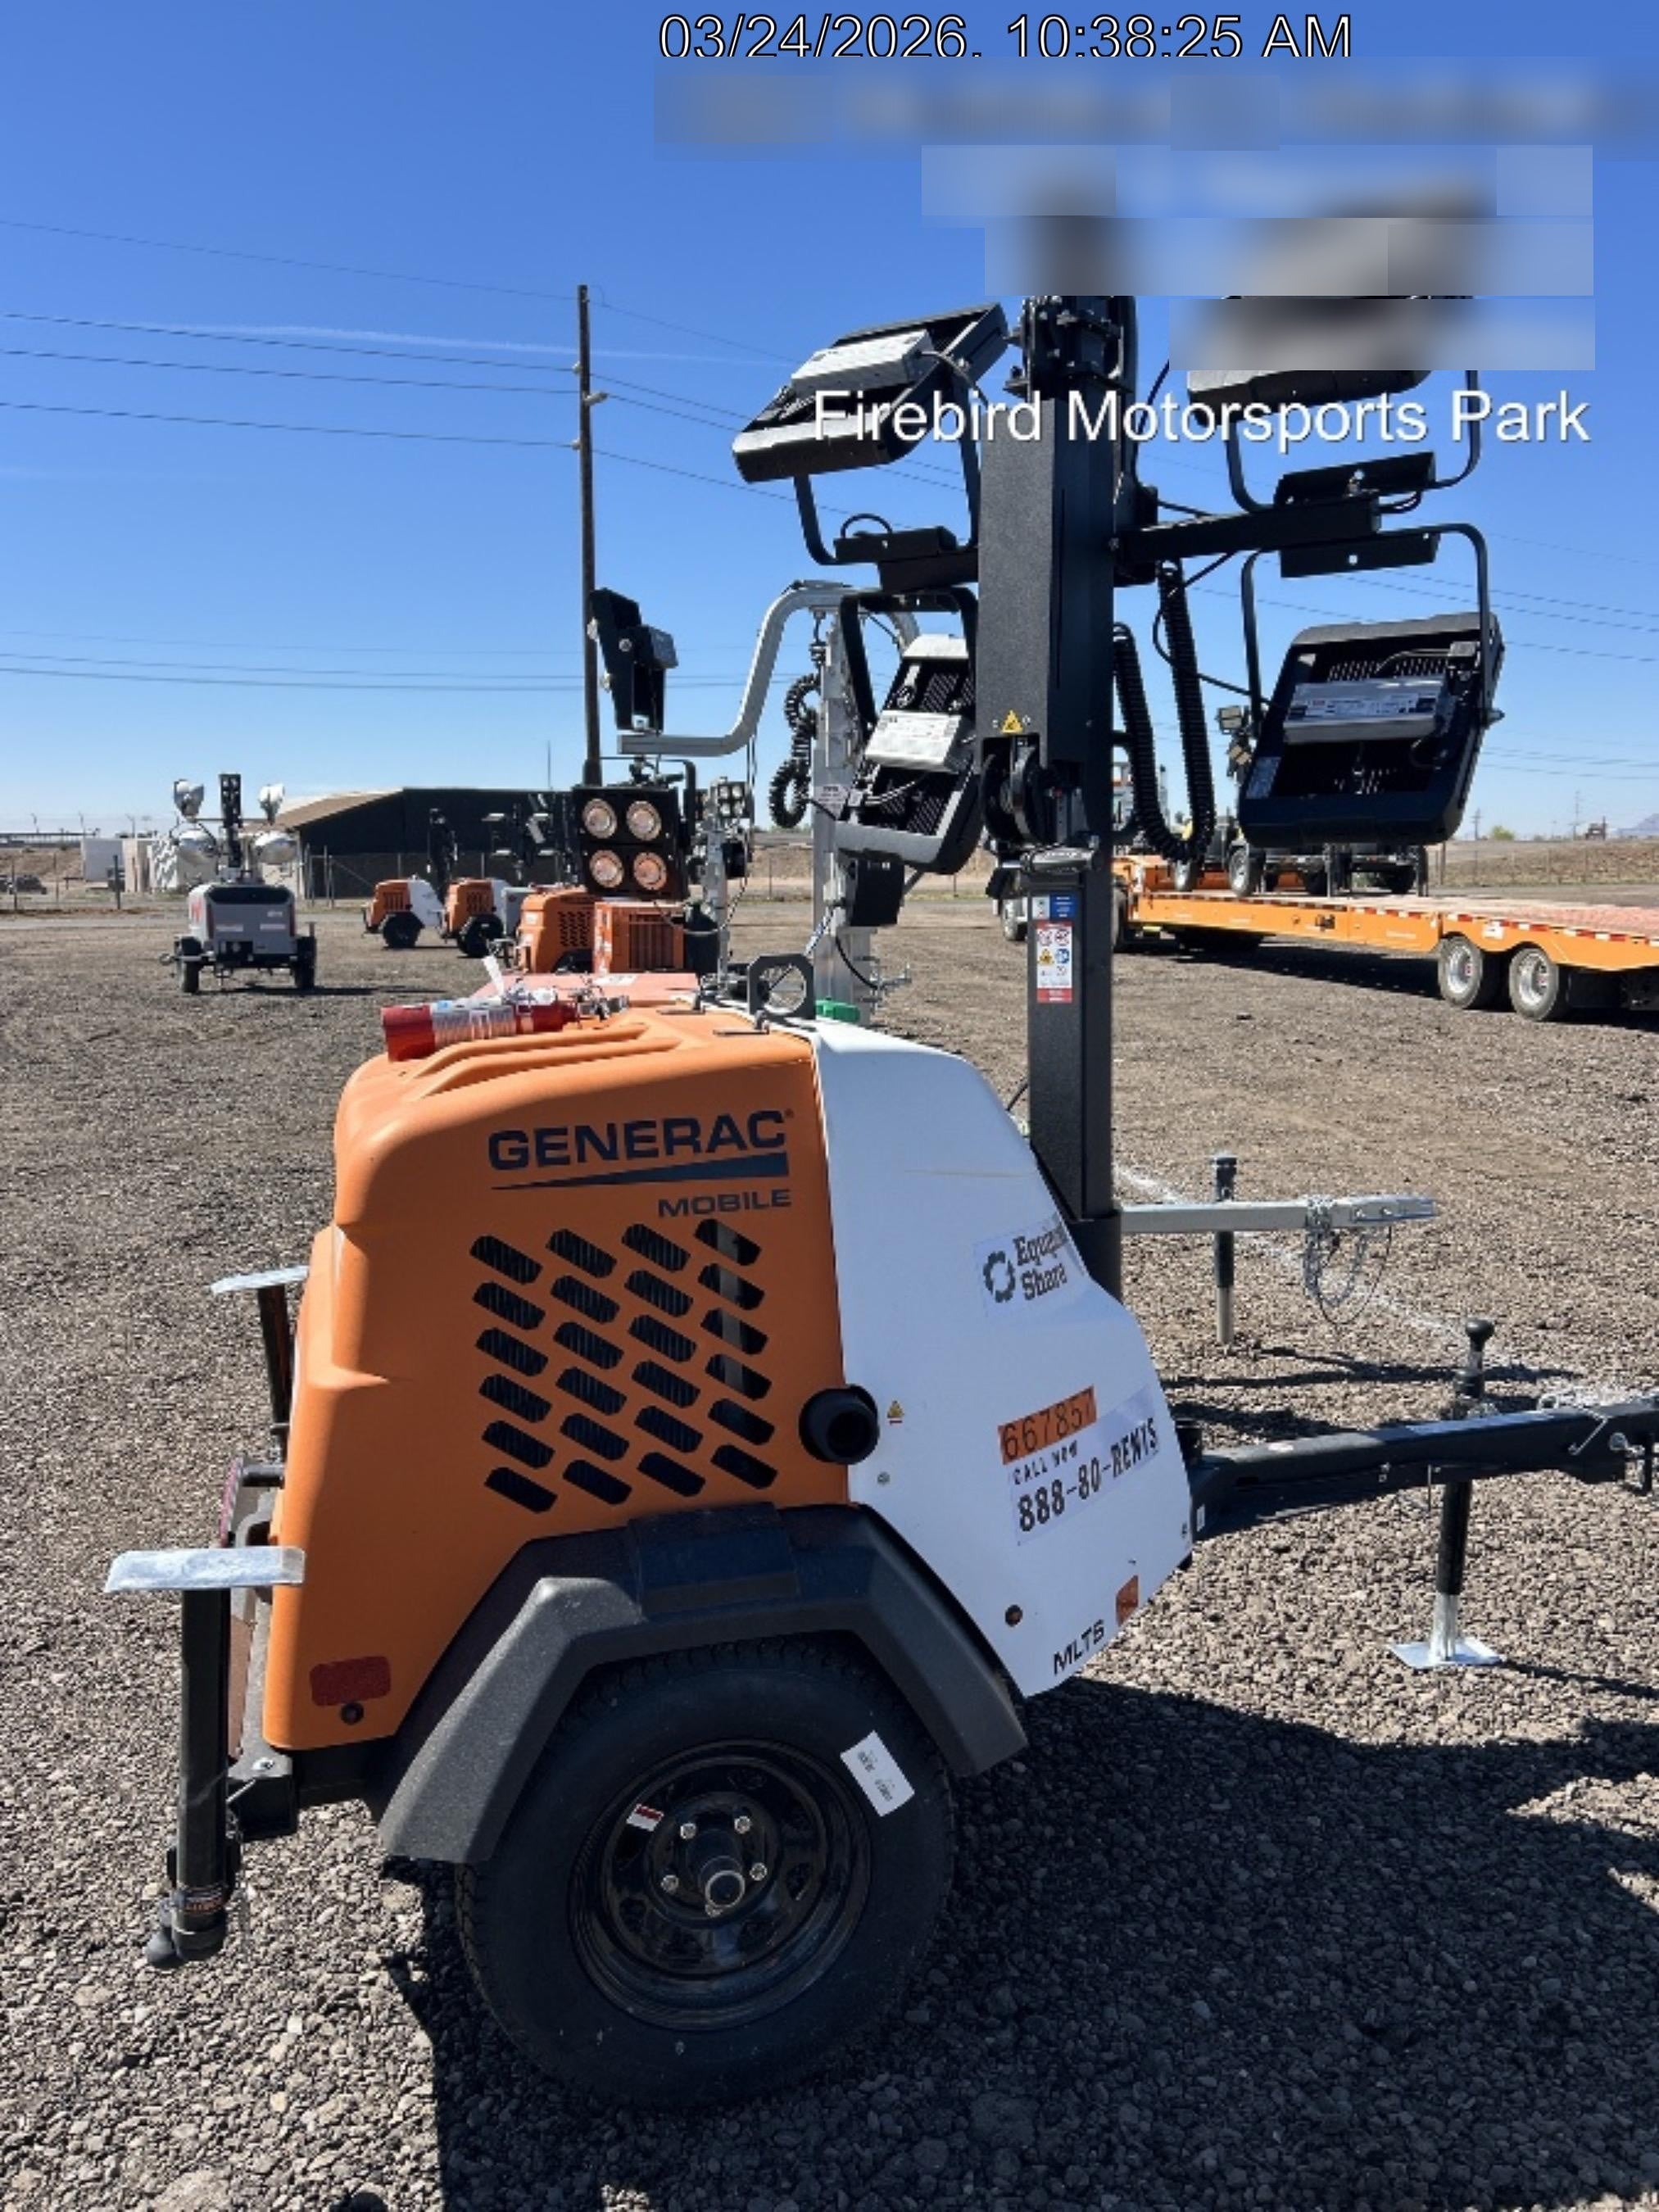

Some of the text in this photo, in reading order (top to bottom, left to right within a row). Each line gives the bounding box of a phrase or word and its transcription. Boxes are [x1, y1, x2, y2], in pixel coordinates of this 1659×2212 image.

[488, 1110, 786, 1171] GENERAC
[658, 1189, 792, 1218] MOBILE
[1004, 1387, 1095, 1461] 667857
[1013, 1457, 1048, 1486] CALL
